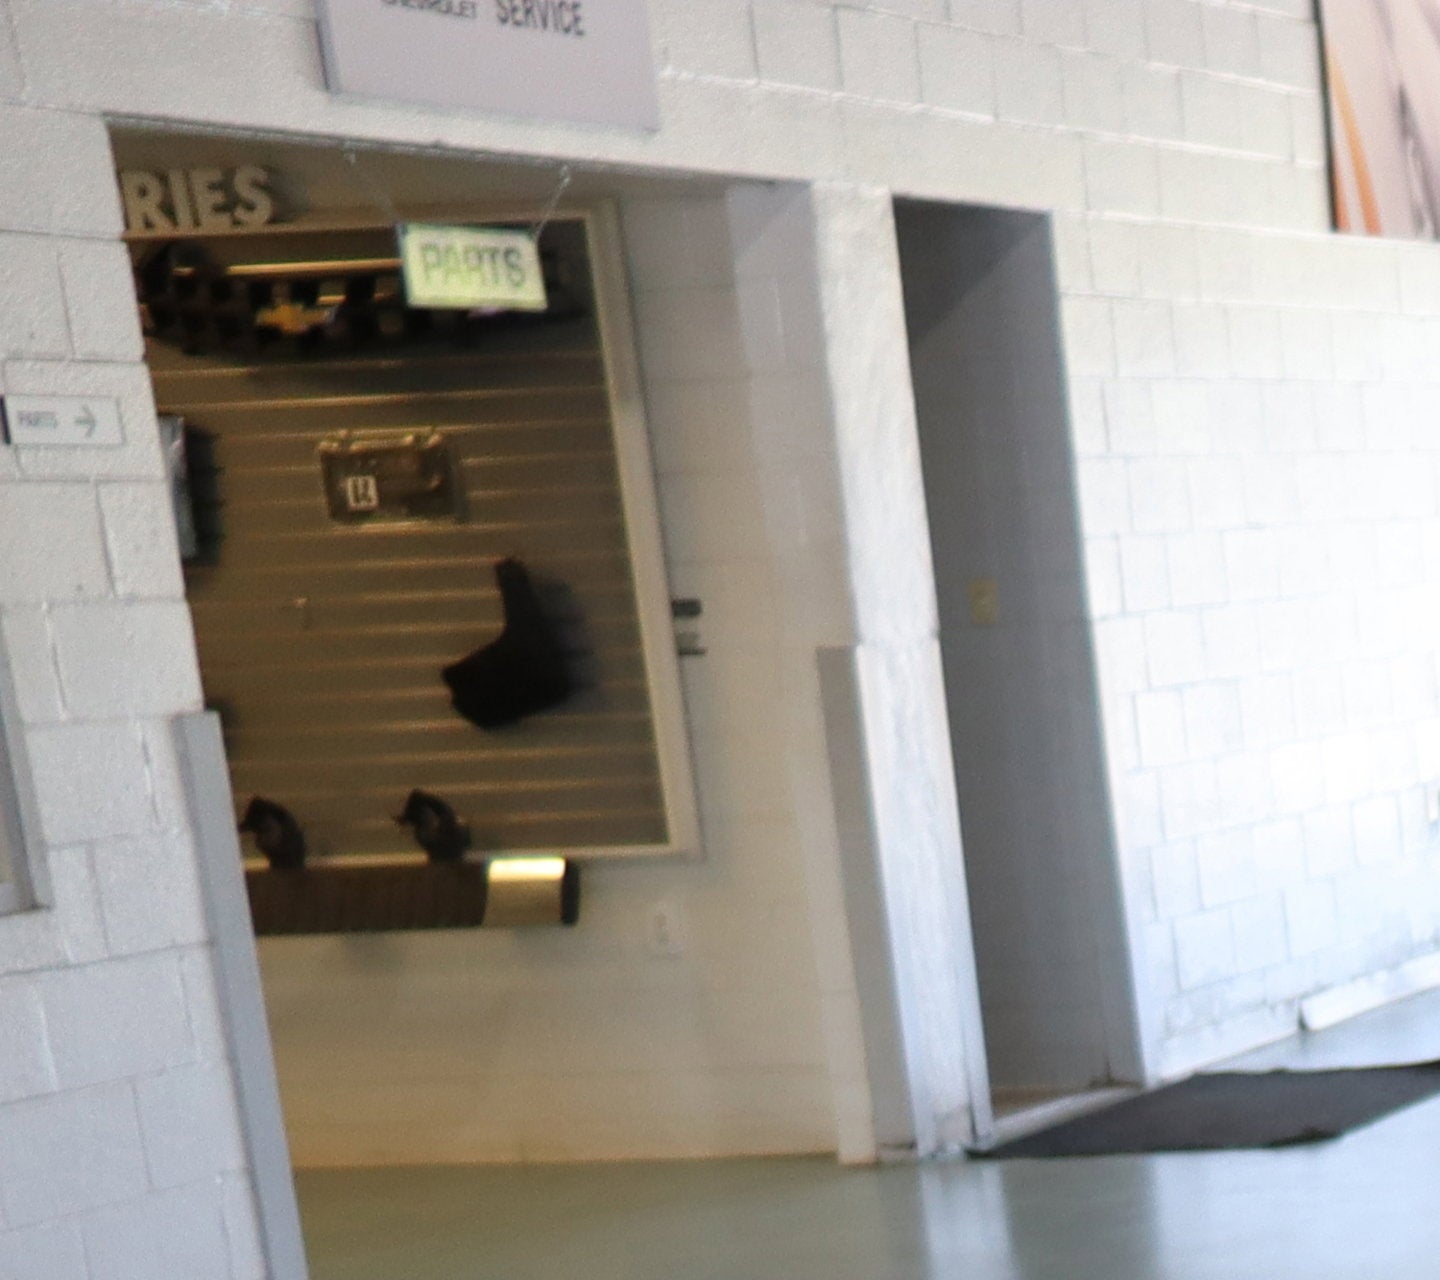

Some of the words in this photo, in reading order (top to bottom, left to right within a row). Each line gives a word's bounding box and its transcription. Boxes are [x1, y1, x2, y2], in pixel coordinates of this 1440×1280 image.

[497, 0, 585, 36] SERVICE
[121, 166, 275, 234] RIES
[419, 242, 527, 288] PARTS
